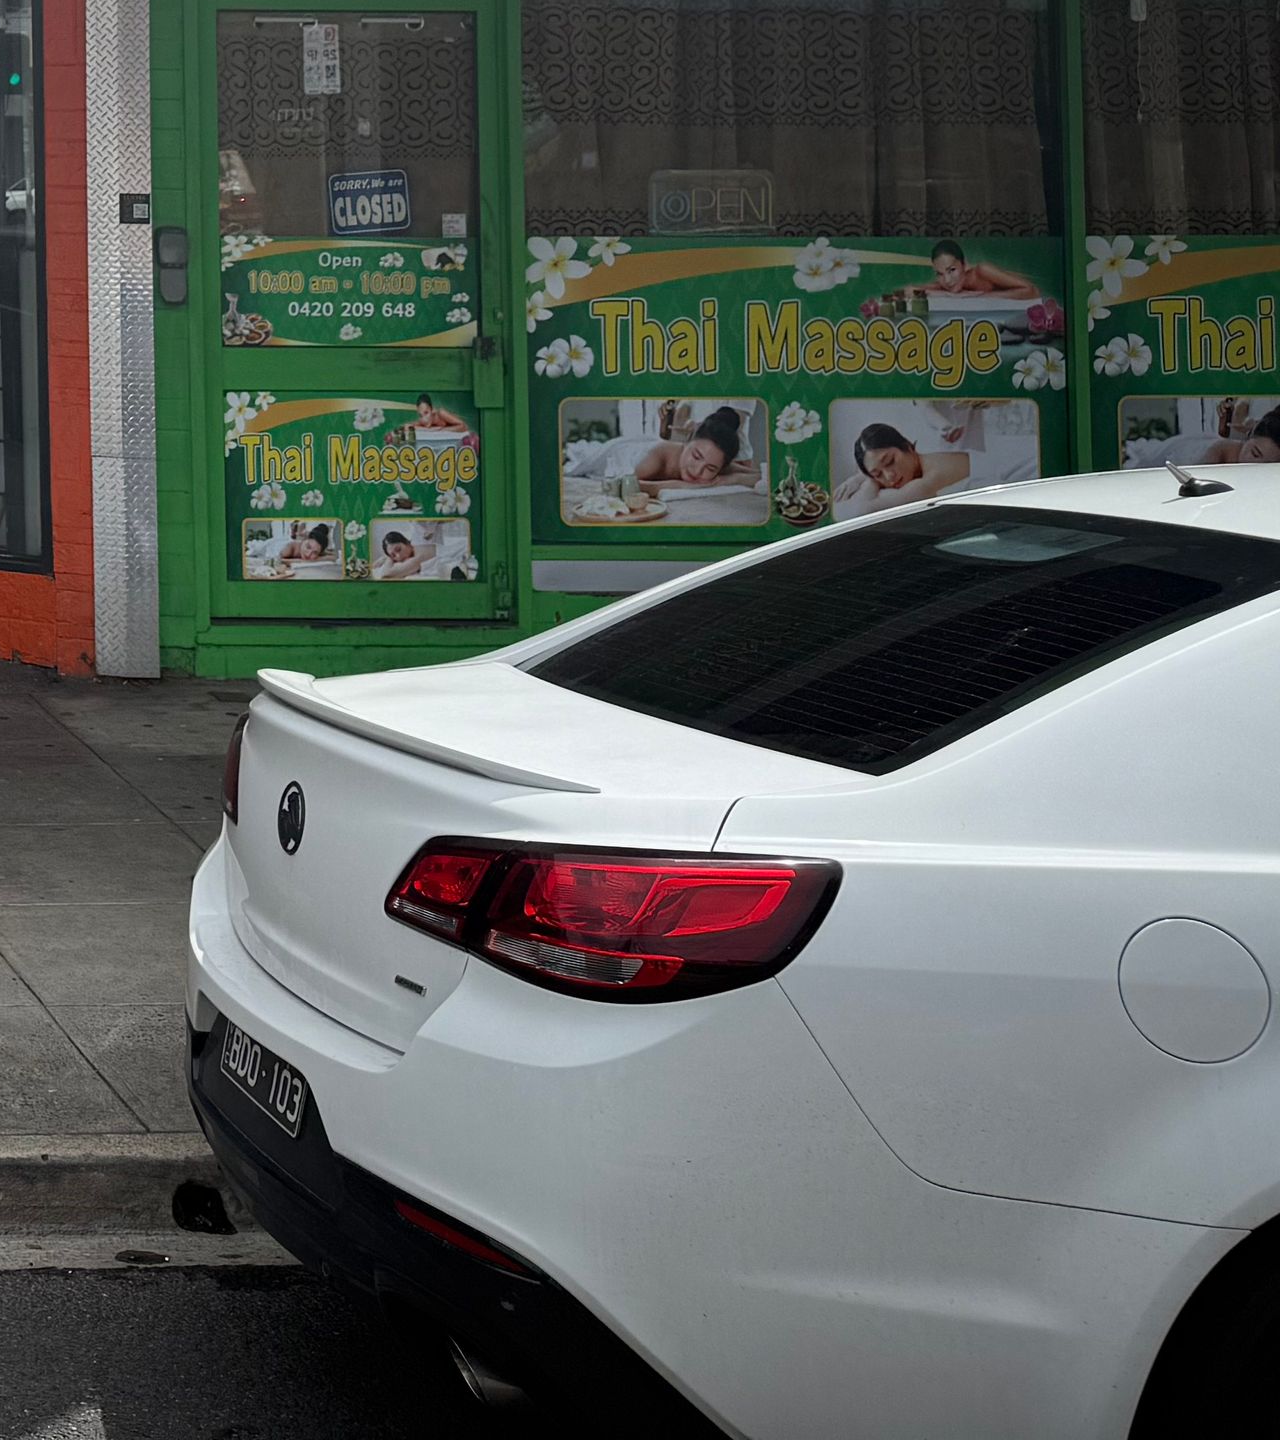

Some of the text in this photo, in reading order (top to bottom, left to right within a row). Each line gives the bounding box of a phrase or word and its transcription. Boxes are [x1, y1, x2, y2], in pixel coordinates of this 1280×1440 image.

[387, 178, 404, 188] are
[334, 192, 407, 228] CLOSED
[660, 187, 766, 223] OPEN
[319, 251, 363, 269] Open
[247, 270, 305, 295] 10:00
[308, 276, 339, 295] am
[360, 270, 417, 295] 10:00
[420, 276, 452, 299] pm
[287, 301, 416, 317] 0420 209 648
[591, 298, 1002, 389] Thai Massage
[1147, 296, 1276, 375] Thai
[238, 432, 479, 493] Thai Massage
